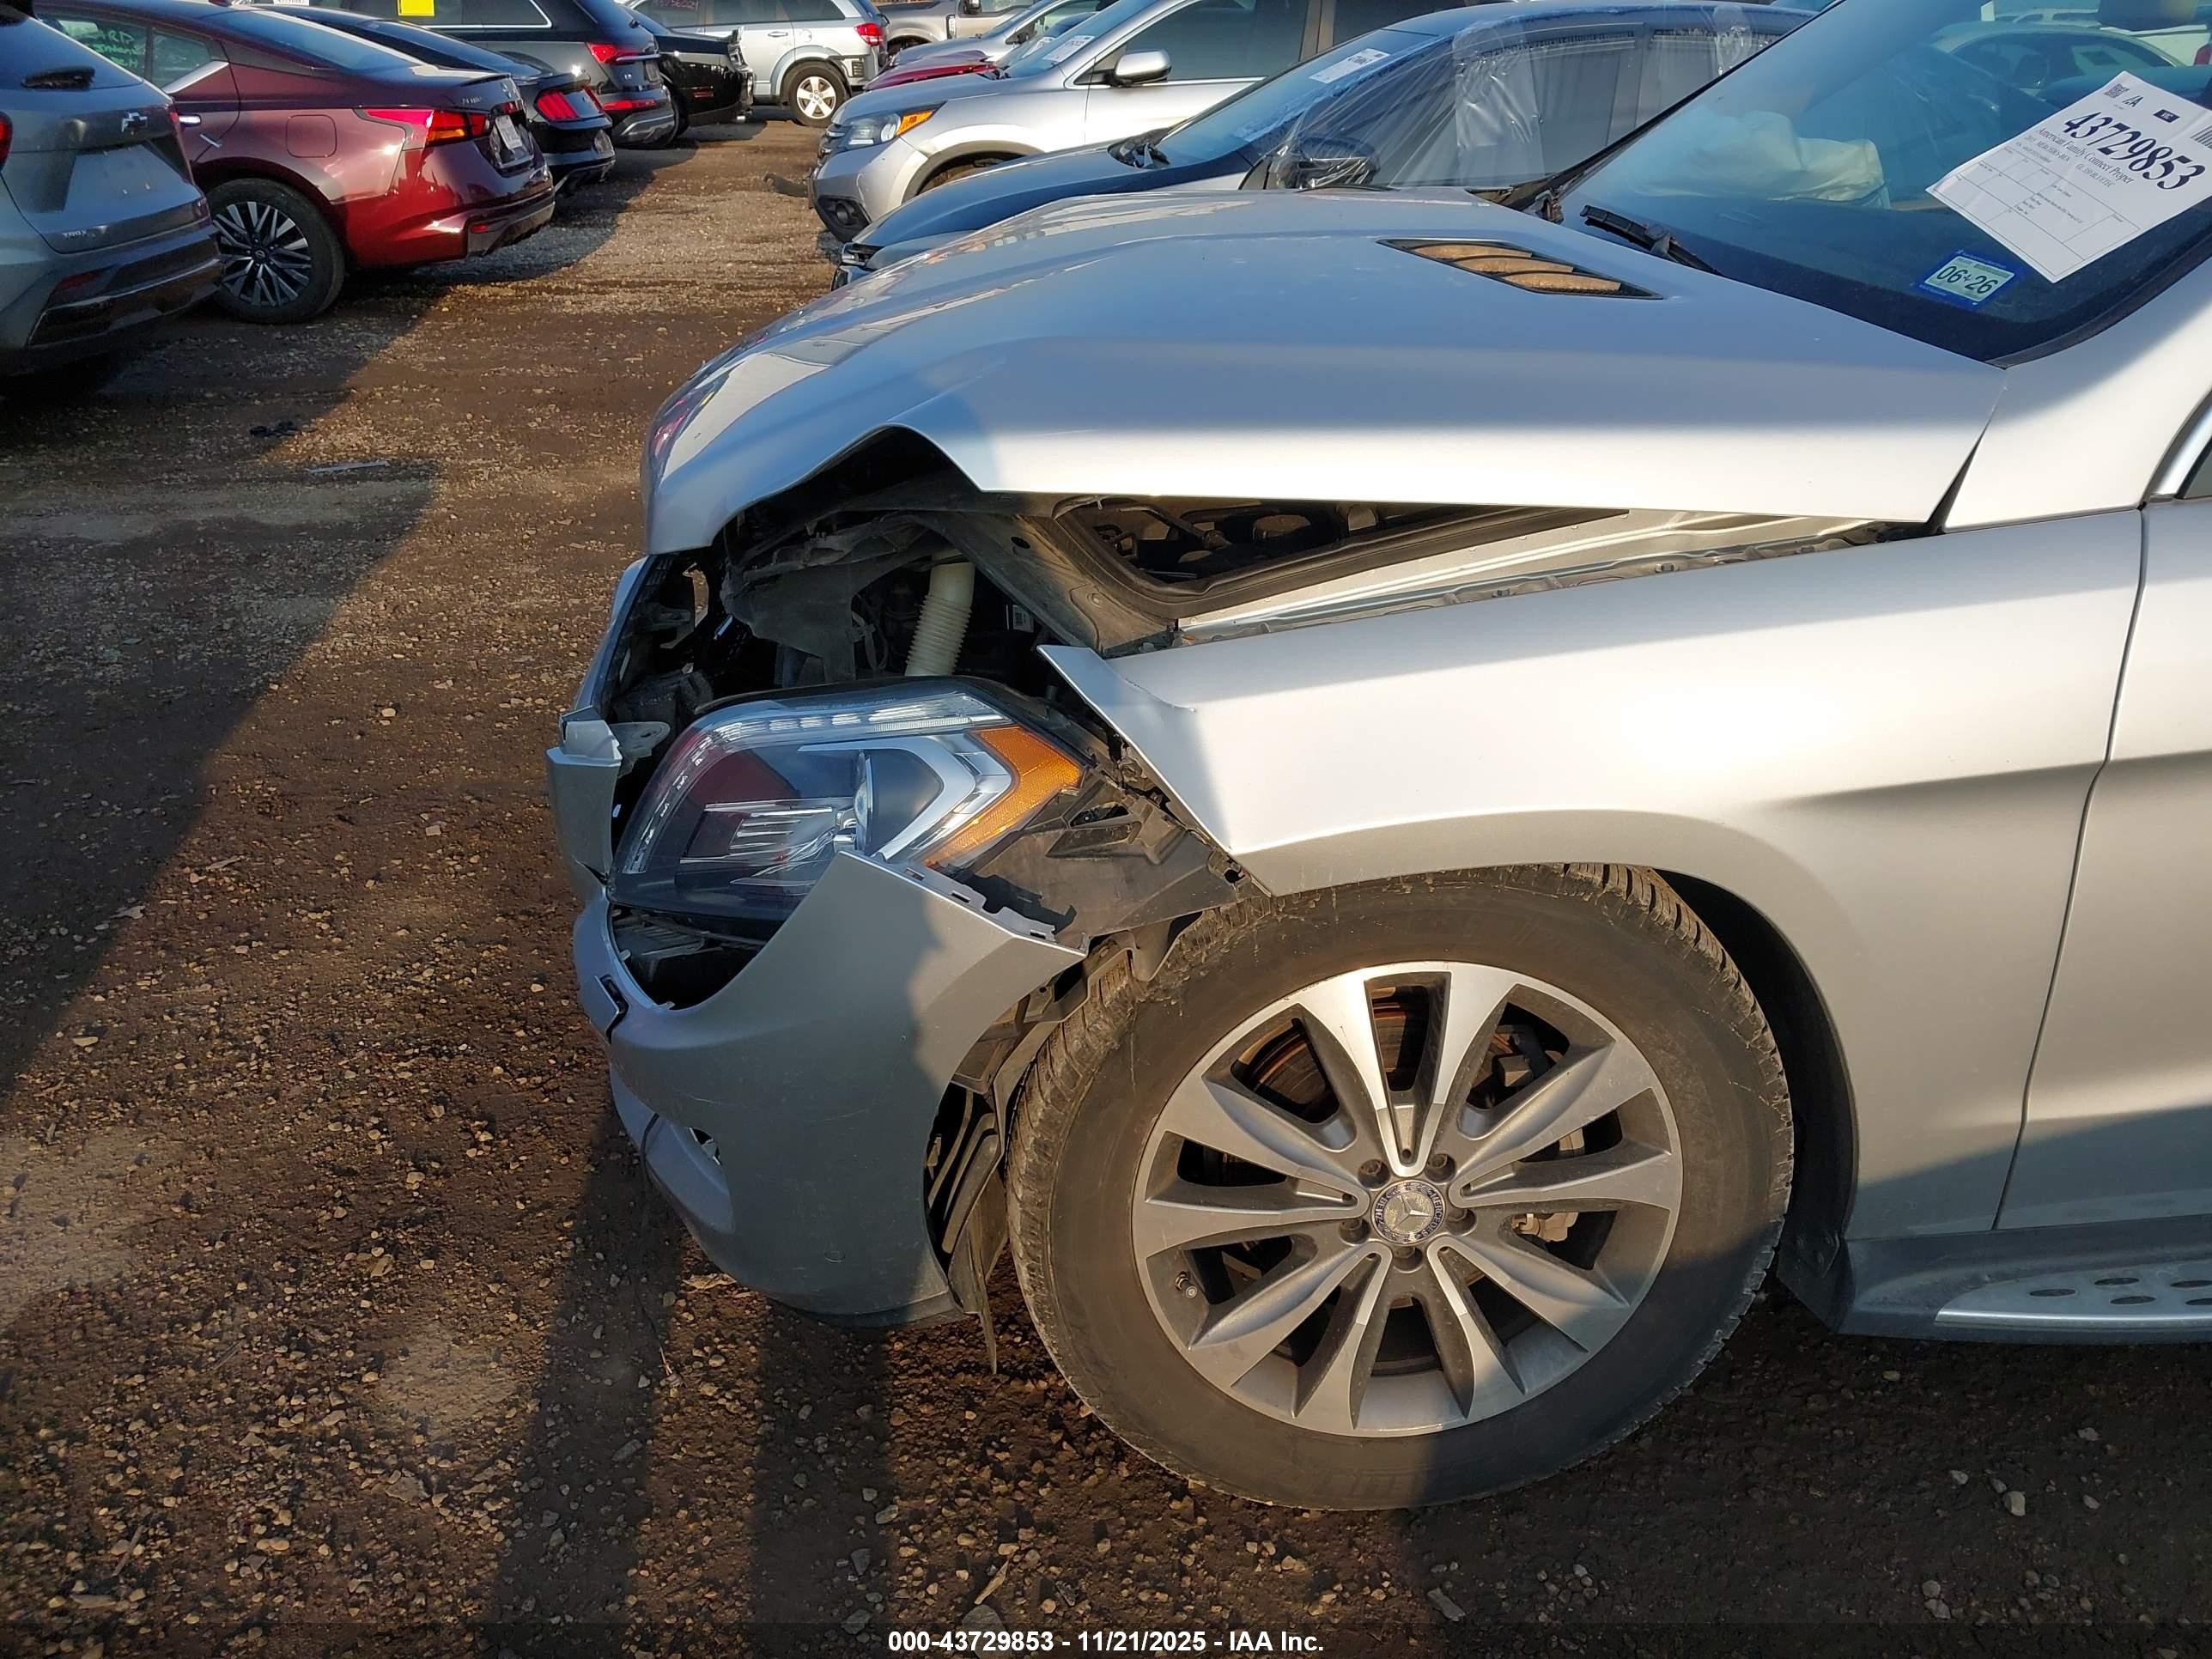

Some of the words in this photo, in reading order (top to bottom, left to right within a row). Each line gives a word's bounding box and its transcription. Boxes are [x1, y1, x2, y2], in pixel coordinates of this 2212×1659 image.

[2037, 128, 2066, 145] American
[2063, 140, 2087, 157] Family
[2085, 153, 2113, 174] Connect
[2108, 166, 2135, 184] Proper
[2063, 112, 2206, 190] 43729853
[1964, 276, 1999, 294] 26
[1421, 1193, 1443, 1237] MERCEDES
